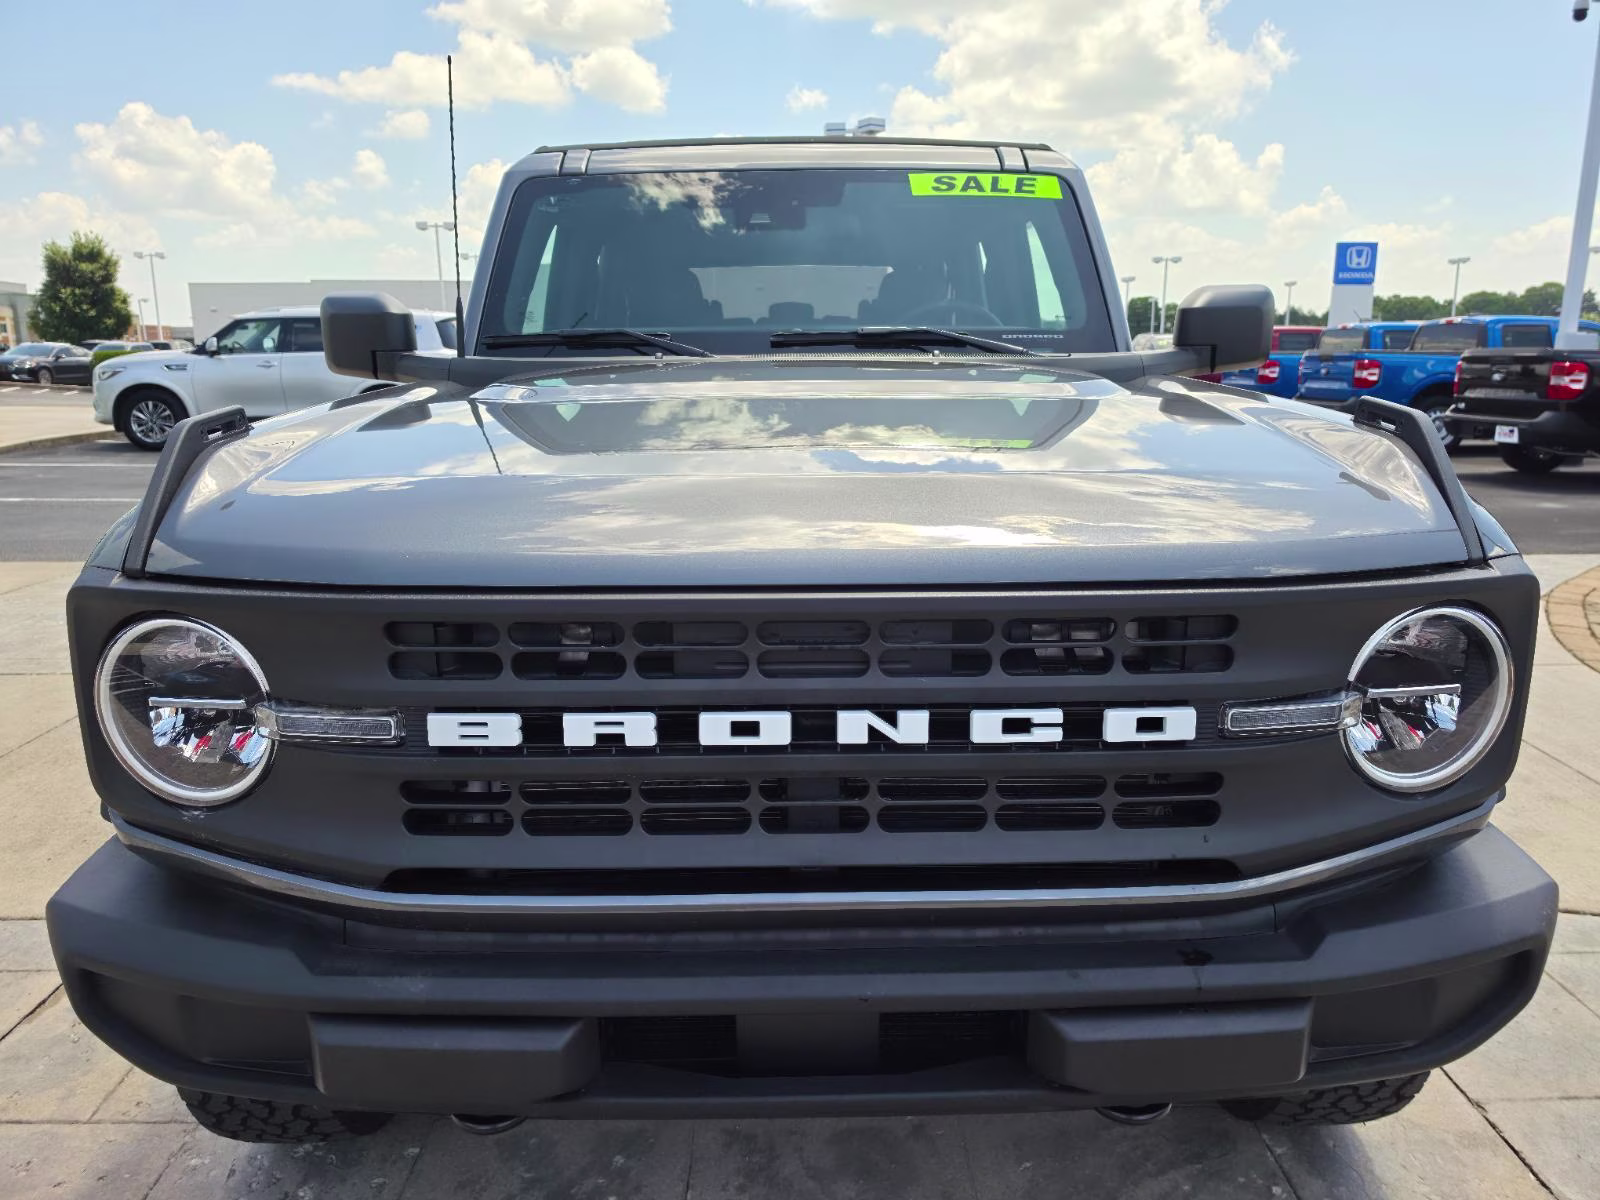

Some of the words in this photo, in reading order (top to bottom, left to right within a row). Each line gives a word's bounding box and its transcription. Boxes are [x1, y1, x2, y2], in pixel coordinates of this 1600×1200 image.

[931, 175, 1037, 194] SALE
[1338, 271, 1374, 279] HONDA
[427, 706, 1197, 747] BRONCO
